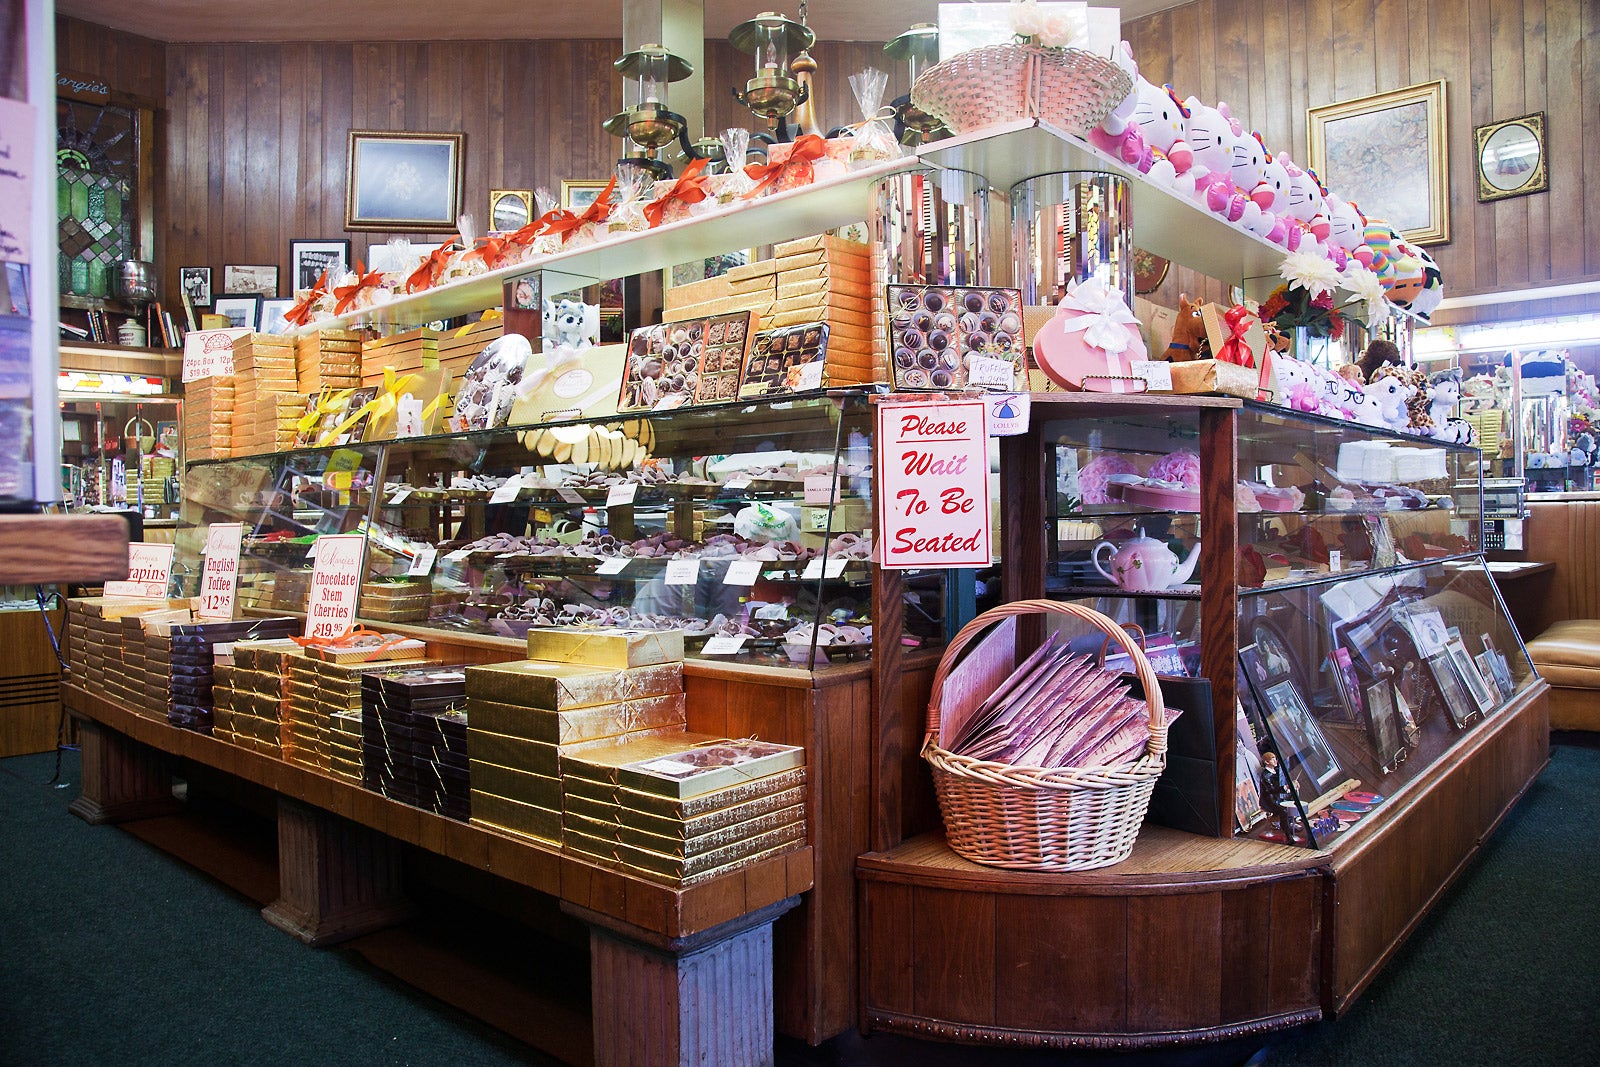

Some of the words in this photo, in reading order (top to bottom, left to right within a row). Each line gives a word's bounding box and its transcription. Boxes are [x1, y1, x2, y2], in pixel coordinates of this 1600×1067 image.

[55, 72, 108, 95] argie's
[900, 414, 967, 438] Please
[901, 450, 968, 476] Wait
[896, 488, 930, 517] To
[939, 487, 975, 514] Be
[890, 527, 982, 554] Seated
[207, 557, 235, 574] English
[208, 576, 231, 591] Toffee
[315, 571, 356, 586] Chocolate
[321, 587, 343, 602] Stem
[313, 603, 349, 619] Cherries
